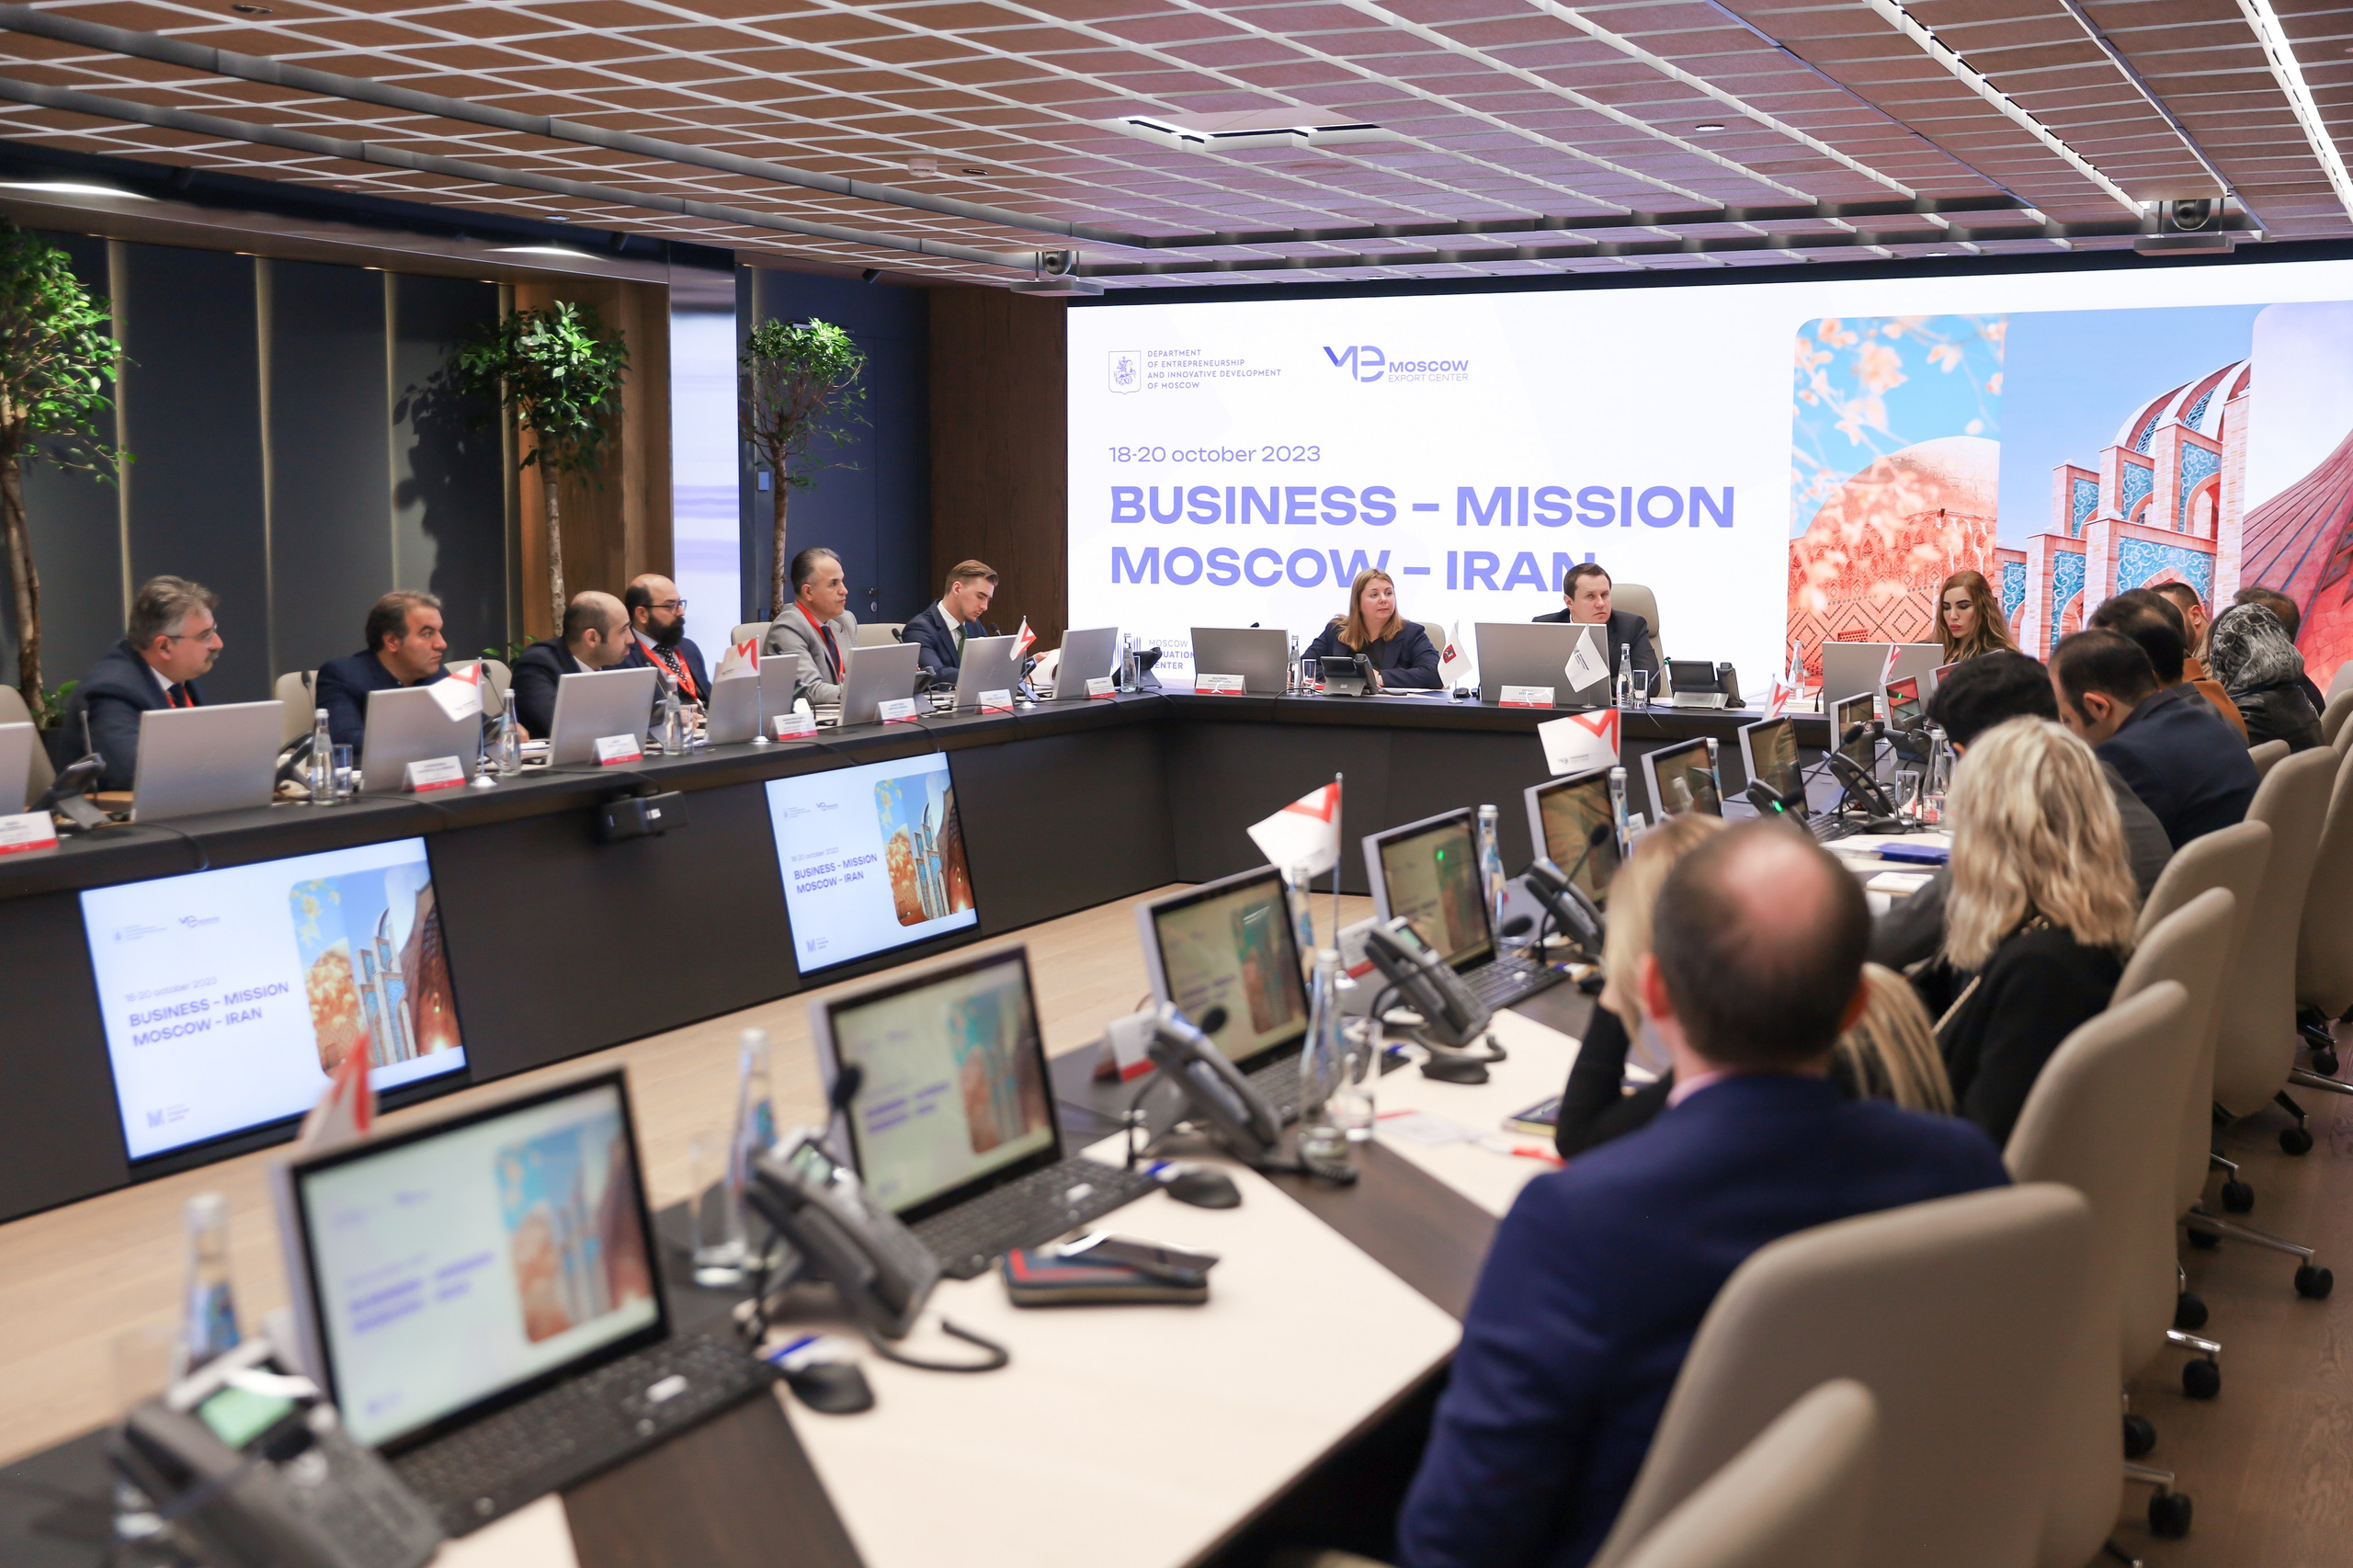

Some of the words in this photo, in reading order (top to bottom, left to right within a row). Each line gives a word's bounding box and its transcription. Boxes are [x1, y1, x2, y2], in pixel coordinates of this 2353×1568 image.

[1147, 349, 1201, 358] DEPARTMENT
[1147, 360, 1159, 369] OF
[1161, 358, 1245, 368] ENTREPRENEURSHIP
[1389, 360, 1469, 373] MOSCOW
[1167, 370, 1217, 379] INNOVATIVE
[1220, 369, 1281, 378] DEVELOPMENT
[1388, 374, 1427, 382] EXPORT
[1427, 373, 1469, 381] CENTER
[1147, 381, 1159, 390] OF
[1108, 447, 1166, 462] 18-20
[1171, 447, 1257, 462] october
[1262, 446, 1321, 461] 2023
[1110, 485, 1397, 527] BUSINESS
[1456, 486, 1734, 528] MISSION
[1111, 546, 1392, 588] MOSCOW
[1148, 639, 1188, 648] MOSCOW
[794, 862, 836, 880] BUSINESS
[842, 853, 878, 869] MISSION
[796, 876, 837, 894] MOSCOW
[844, 869, 864, 883] IRAN
[130, 998, 210, 1028] BUSINESS
[224, 981, 290, 1006] MISSION
[133, 1017, 211, 1047] MOSCOW
[225, 1006, 263, 1026] IRAN
